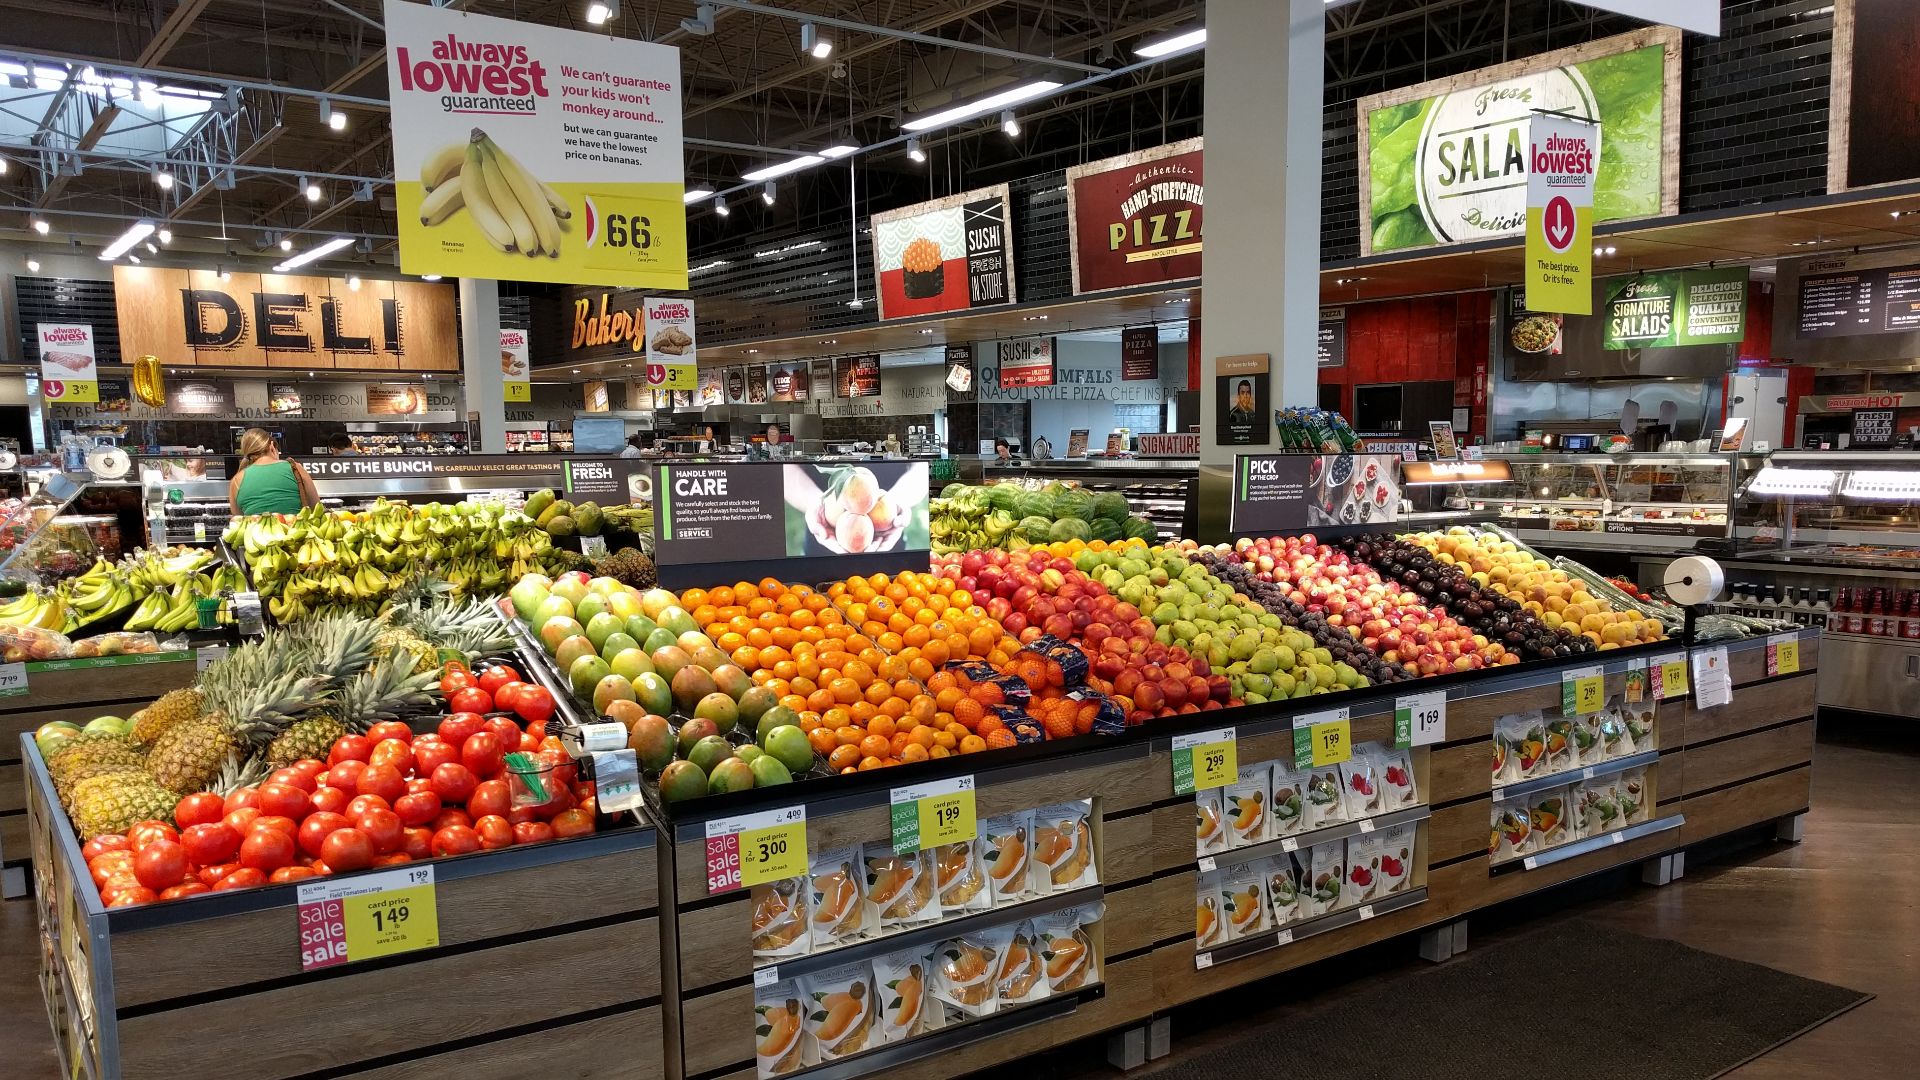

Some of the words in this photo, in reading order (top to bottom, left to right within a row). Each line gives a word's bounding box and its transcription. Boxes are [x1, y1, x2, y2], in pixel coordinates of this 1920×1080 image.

[432, 33, 528, 67] always
[396, 47, 549, 98] lowest
[560, 65, 579, 79] We
[582, 70, 610, 83] can't
[612, 75, 671, 92] guarantee
[441, 95, 536, 112] guaranteed
[561, 85, 589, 97] your
[592, 86, 616, 101] kids
[618, 93, 650, 106] won't
[562, 102, 610, 119] monkey
[612, 109, 664, 124] around...
[563, 123, 580, 133] but
[581, 126, 594, 135] we
[596, 128, 611, 137] can
[613, 130, 658, 143] guarantee
[564, 138, 577, 146] we
[579, 138, 601, 149] have
[602, 141, 617, 151] the
[619, 142, 647, 154] lowest
[1546, 132, 1586, 155] always
[565, 150, 588, 160] price
[589, 152, 601, 162] on
[602, 153, 642, 166] bananas.
[1437, 127, 1525, 188] SALA
[1531, 143, 1592, 174] lowest
[1546, 173, 1586, 187] guaranteed
[603, 213, 651, 249] .66
[968, 225, 1000, 251] SUSHI
[1108, 209, 1203, 251] PIZZ
[970, 256, 1002, 273] FRESH
[1537, 260, 1549, 270] The
[1550, 261, 1563, 271] best
[1563, 264, 1580, 274] price.
[971, 276, 980, 301] IN
[980, 271, 1004, 300] STORE
[1543, 273, 1551, 283] Or
[1561, 275, 1575, 285] free.
[1690, 281, 1742, 293] DELICIOUS
[1625, 281, 1659, 298] Fresh
[1690, 292, 1741, 304] SELECTION
[649, 307, 690, 321] lowest
[657, 302, 685, 312] always
[1613, 299, 1670, 317] SIGNATURE
[1689, 302, 1742, 317] QUALITY
[178, 288, 405, 356] DELI
[571, 293, 645, 352] Bakery
[1612, 315, 1671, 337] SALADS
[1689, 314, 1739, 325] CONVENIENT
[43, 331, 88, 342] lowest
[53, 327, 82, 336] always
[1688, 324, 1739, 336] GOURMET
[1002, 341, 1031, 362] SUSHI
[901, 387, 934, 399] NATURAL
[980, 386, 1028, 400] NAPOLI
[1033, 385, 1068, 400] STYLE
[1073, 387, 1105, 401] PIZZA
[1827, 399, 1868, 408] CAUTION
[1868, 395, 1903, 408] HOT
[1856, 412, 1891, 420] FRESH
[1856, 420, 1880, 428] HOT
[1855, 427, 1891, 435] READY
[1141, 435, 1200, 455] SIGNATURE
[1367, 442, 1417, 453] CHICKEN
[330, 462, 350, 474] OF
[352, 461, 380, 473] THE
[383, 460, 433, 473] BUNCH
[572, 467, 613, 480] FRESH
[675, 470, 707, 478] HANDLE
[707, 469, 727, 477] WITH
[1250, 460, 1277, 474] PICK
[675, 478, 728, 496] CARE
[684, 500, 704, 508] carefully
[679, 529, 710, 538] SERVICE
[43, 661, 71, 669] Organic
[90, 658, 117, 666] Organic
[135, 654, 161, 663] Organic
[1652, 687, 1665, 699] sale
[1294, 743, 1312, 757] special
[1295, 754, 1314, 770] special
[1173, 765, 1193, 780] special
[1174, 778, 1195, 795] special
[933, 801, 946, 809] card
[946, 799, 961, 809] price
[892, 805, 917, 823] special
[892, 820, 918, 837] special
[707, 834, 736, 856] sale
[756, 834, 771, 843] card
[771, 832, 788, 842] price
[892, 834, 921, 856] special
[707, 852, 739, 873] sale
[708, 869, 741, 891] sale
[329, 890, 344, 899] Field
[343, 887, 368, 897] Tomatoes
[368, 885, 383, 894] Large
[367, 897, 388, 910] card
[388, 896, 410, 908] price
[300, 901, 340, 925] sale
[301, 921, 344, 946] sale
[376, 937, 391, 945] save
[302, 941, 347, 966] sale
